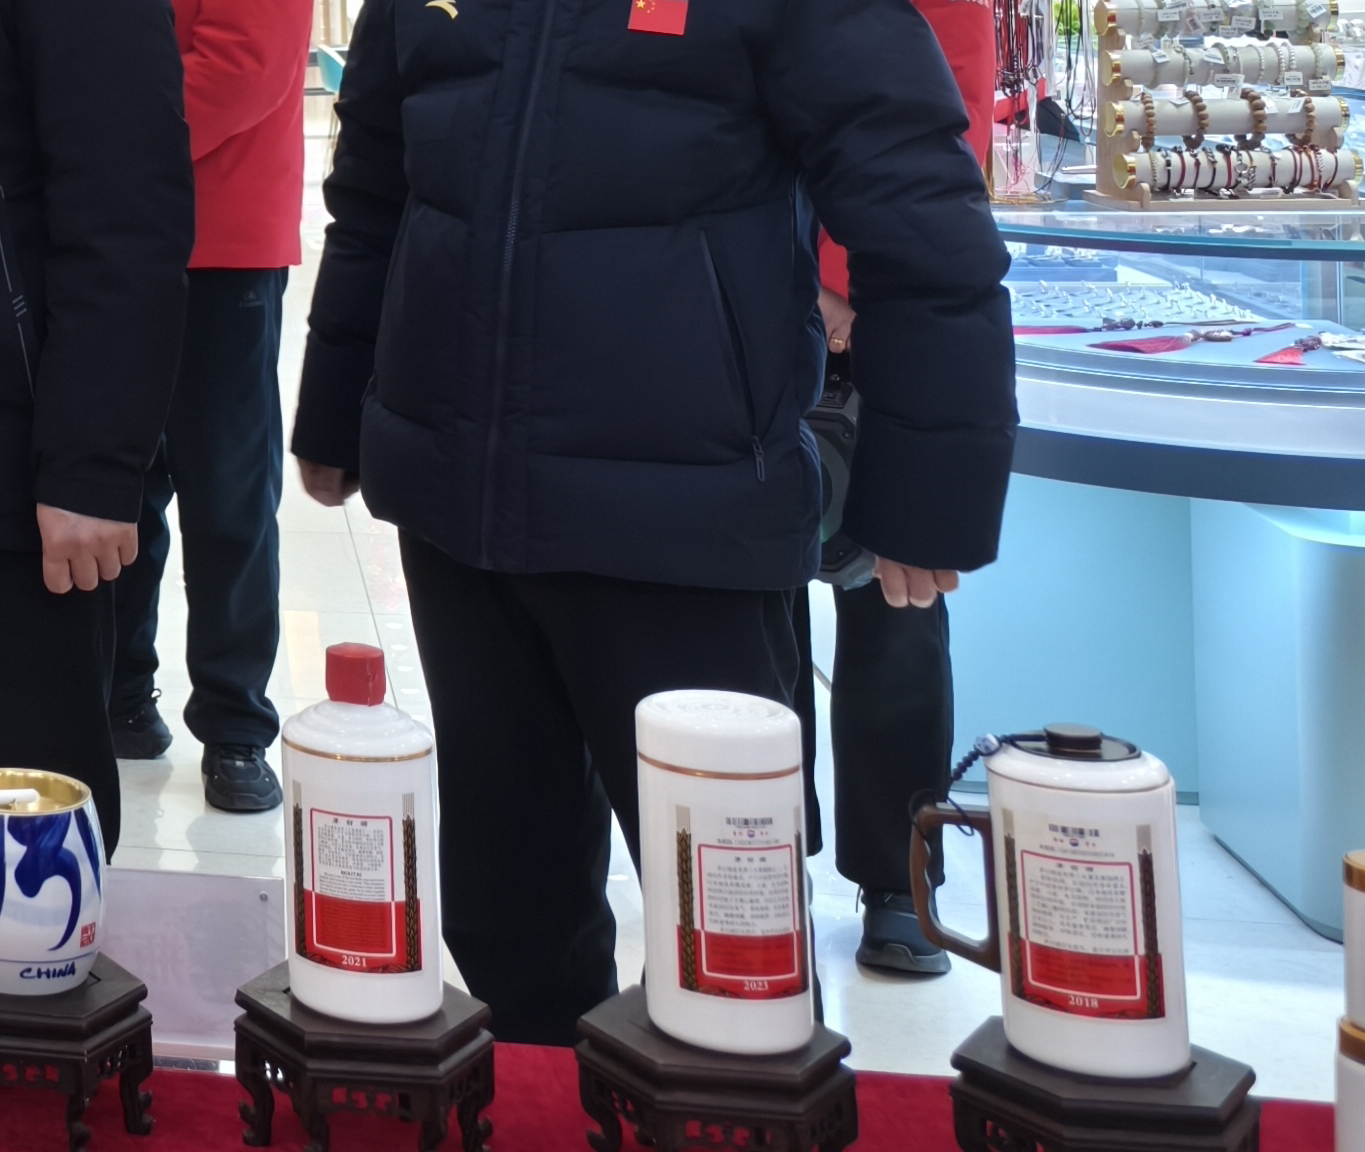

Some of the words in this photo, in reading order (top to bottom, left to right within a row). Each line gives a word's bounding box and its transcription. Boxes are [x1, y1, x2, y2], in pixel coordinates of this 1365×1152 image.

[341, 954, 367, 968] 2021
[19, 961, 77, 980] CHINA
[1068, 994, 1099, 1009] 2018
